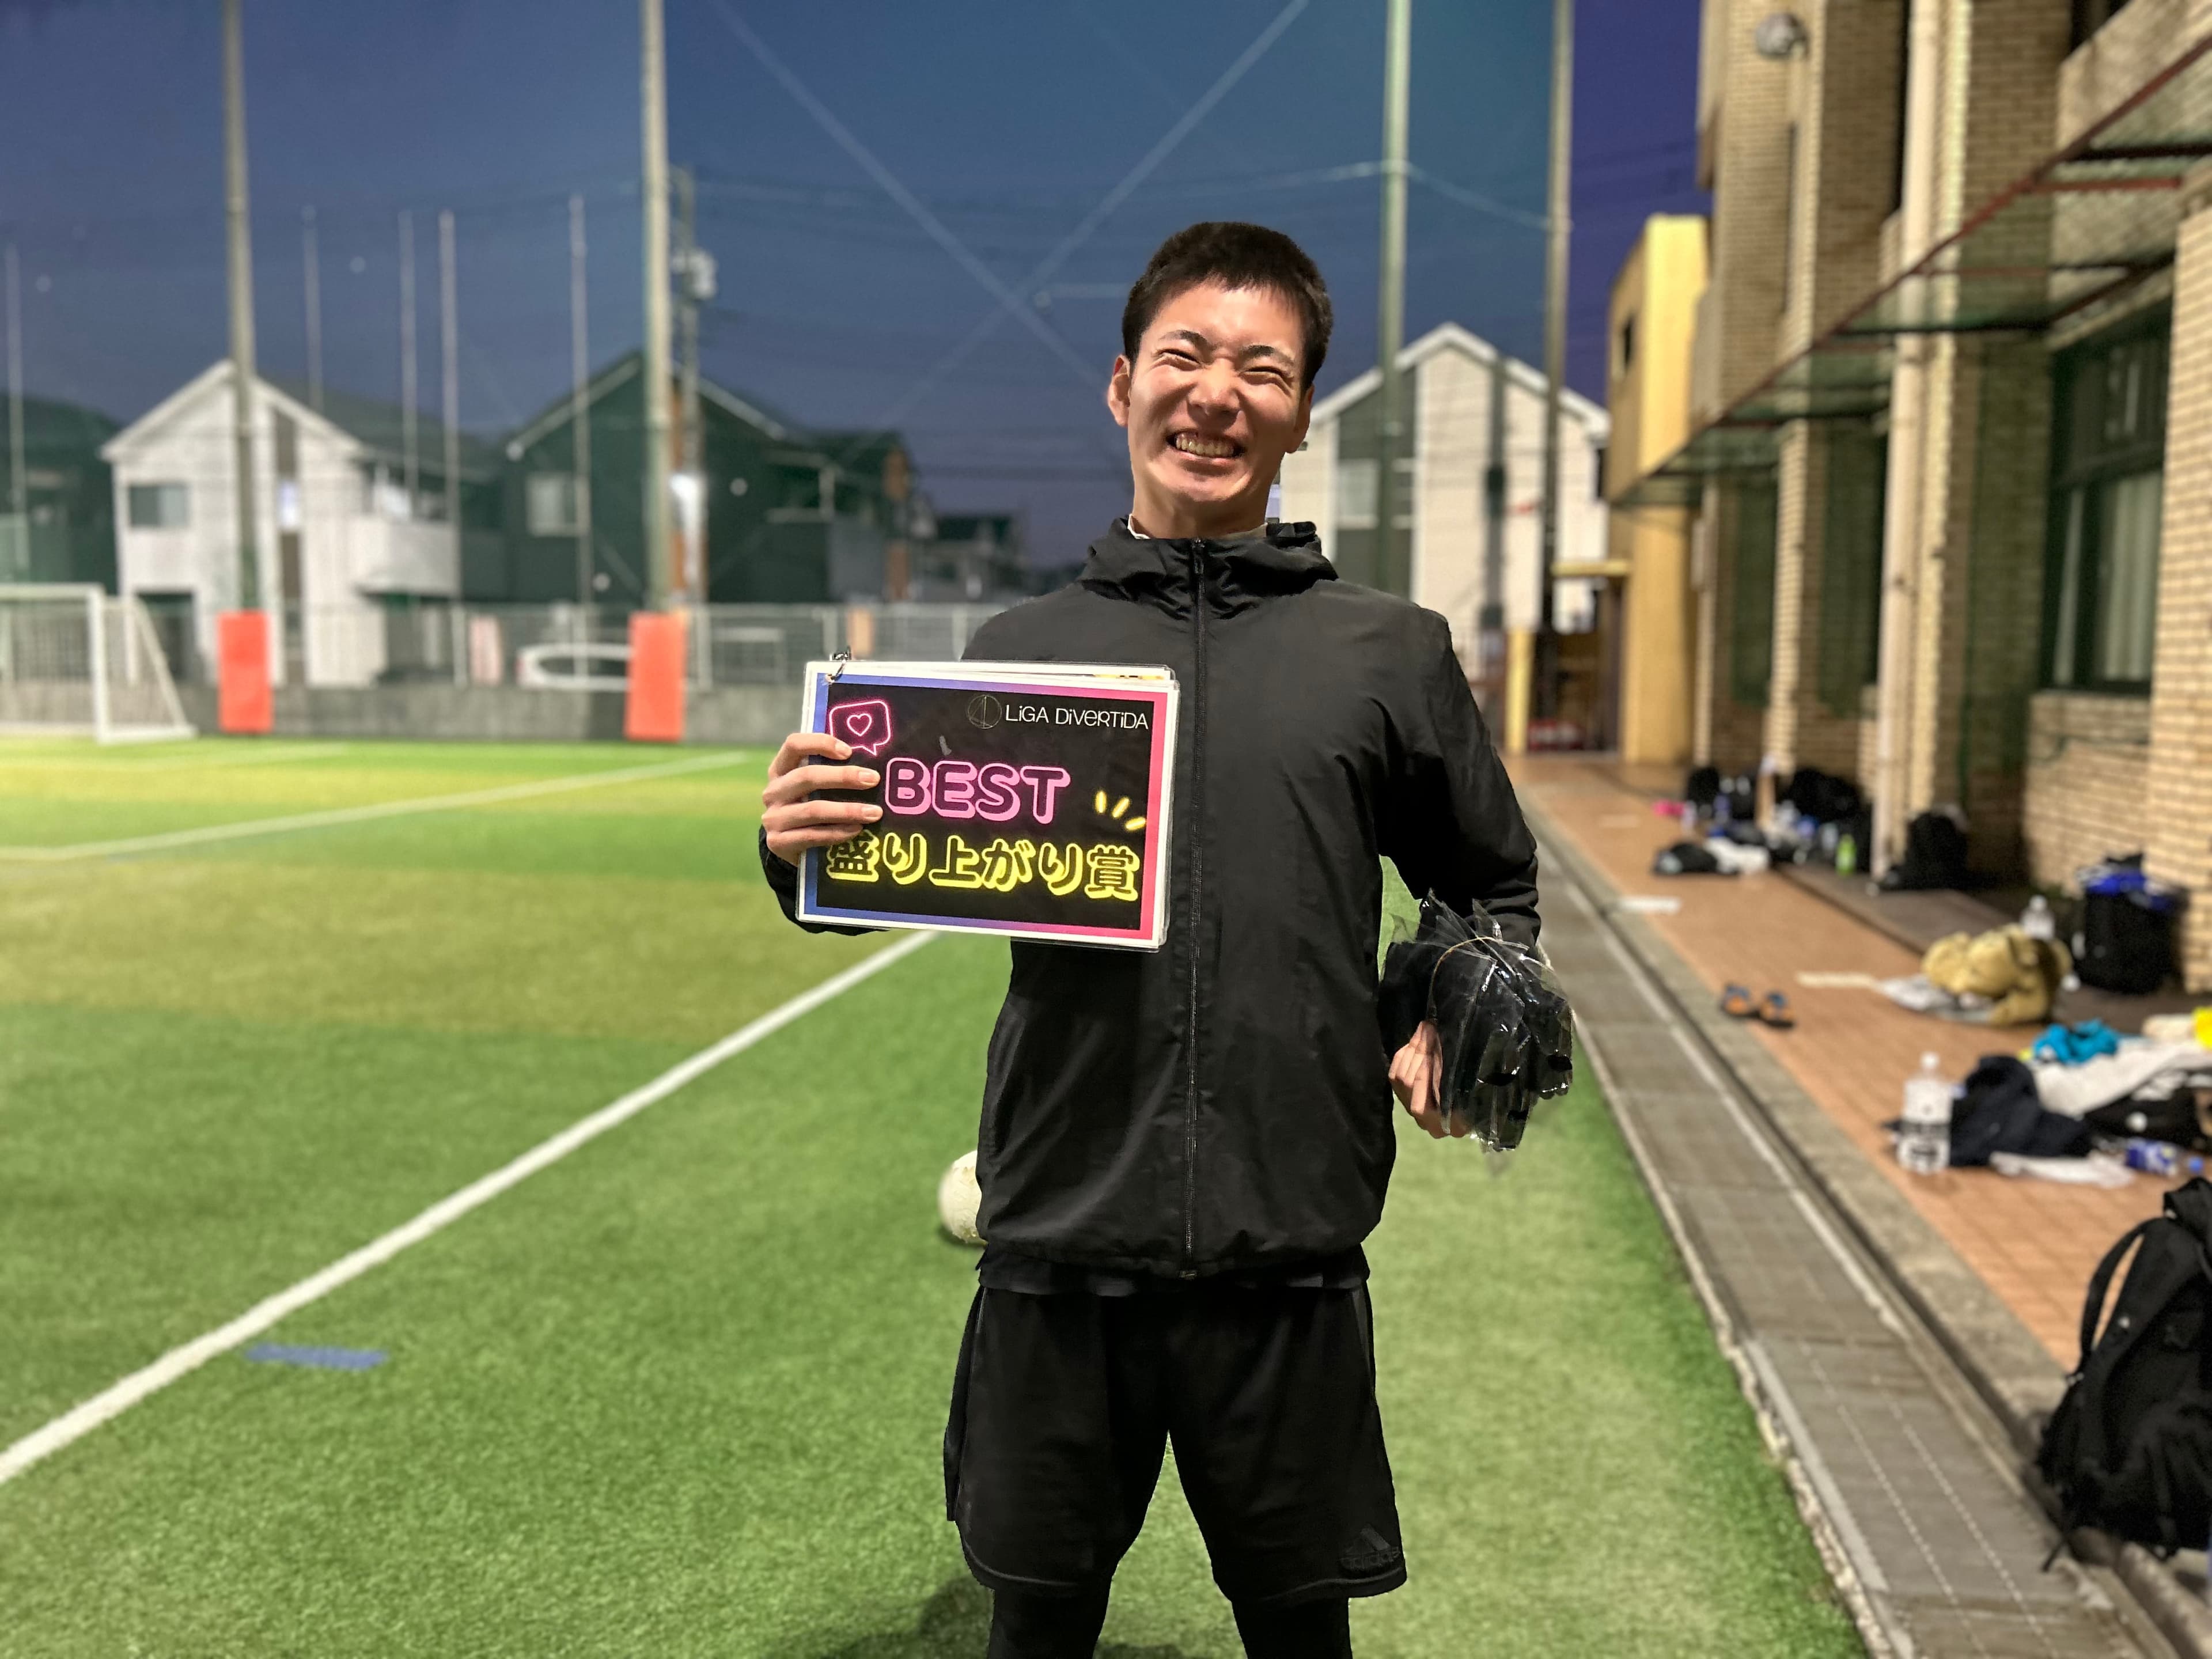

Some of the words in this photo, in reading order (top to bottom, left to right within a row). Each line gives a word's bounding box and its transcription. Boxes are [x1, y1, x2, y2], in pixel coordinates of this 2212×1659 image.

[885, 757, 1070, 824] BEST
[826, 830, 1141, 901] 盛り上がり賞
